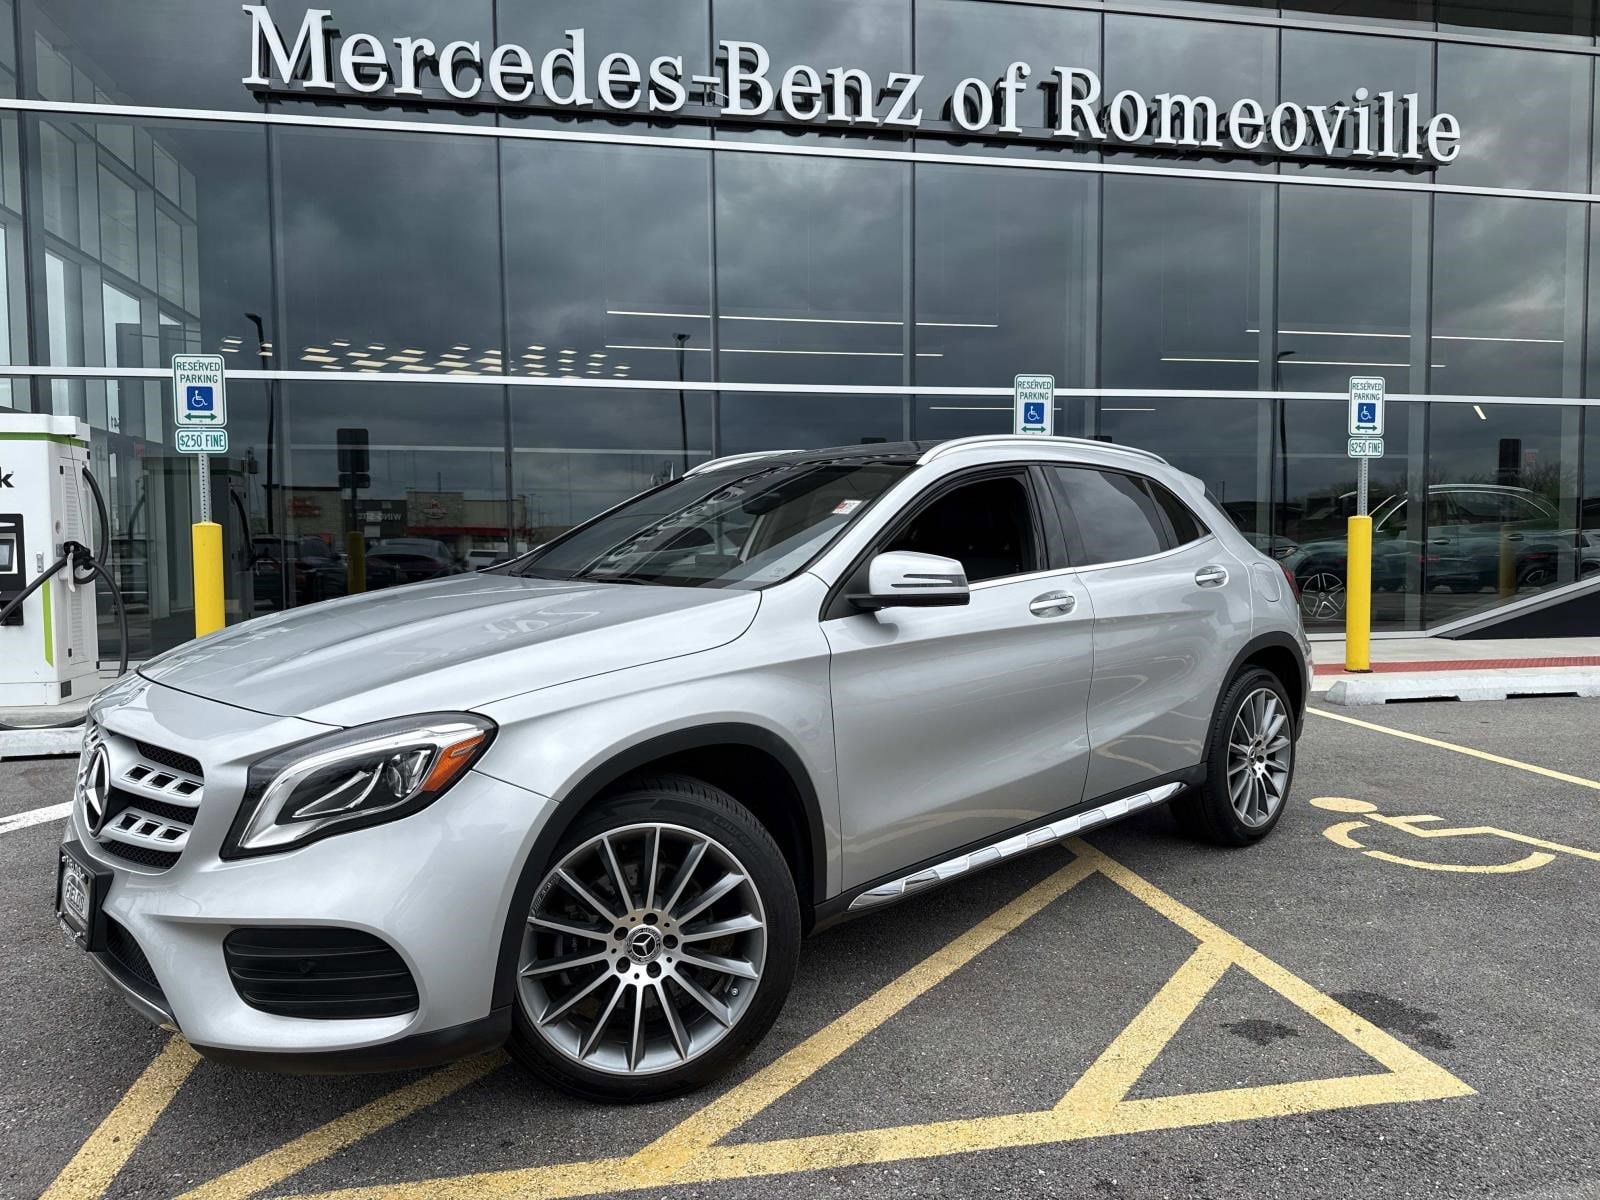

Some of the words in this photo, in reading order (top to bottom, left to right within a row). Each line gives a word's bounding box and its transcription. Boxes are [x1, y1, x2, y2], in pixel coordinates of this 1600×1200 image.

[242, 4, 924, 127] Mercedes-Benz
[952, 61, 1031, 134] of
[1052, 65, 1461, 163] Romeoville
[176, 361, 221, 372] RESERVED
[179, 374, 218, 384] PARKING
[1017, 380, 1052, 390] RESERVED
[1351, 382, 1383, 391] RESERVED
[1019, 391, 1049, 401] PARKING
[1353, 392, 1381, 401] PARKING
[179, 434, 202, 448] $250
[205, 434, 225, 448] FINE
[1350, 442, 1367, 454] $250
[1368, 442, 1382, 454] FINE
